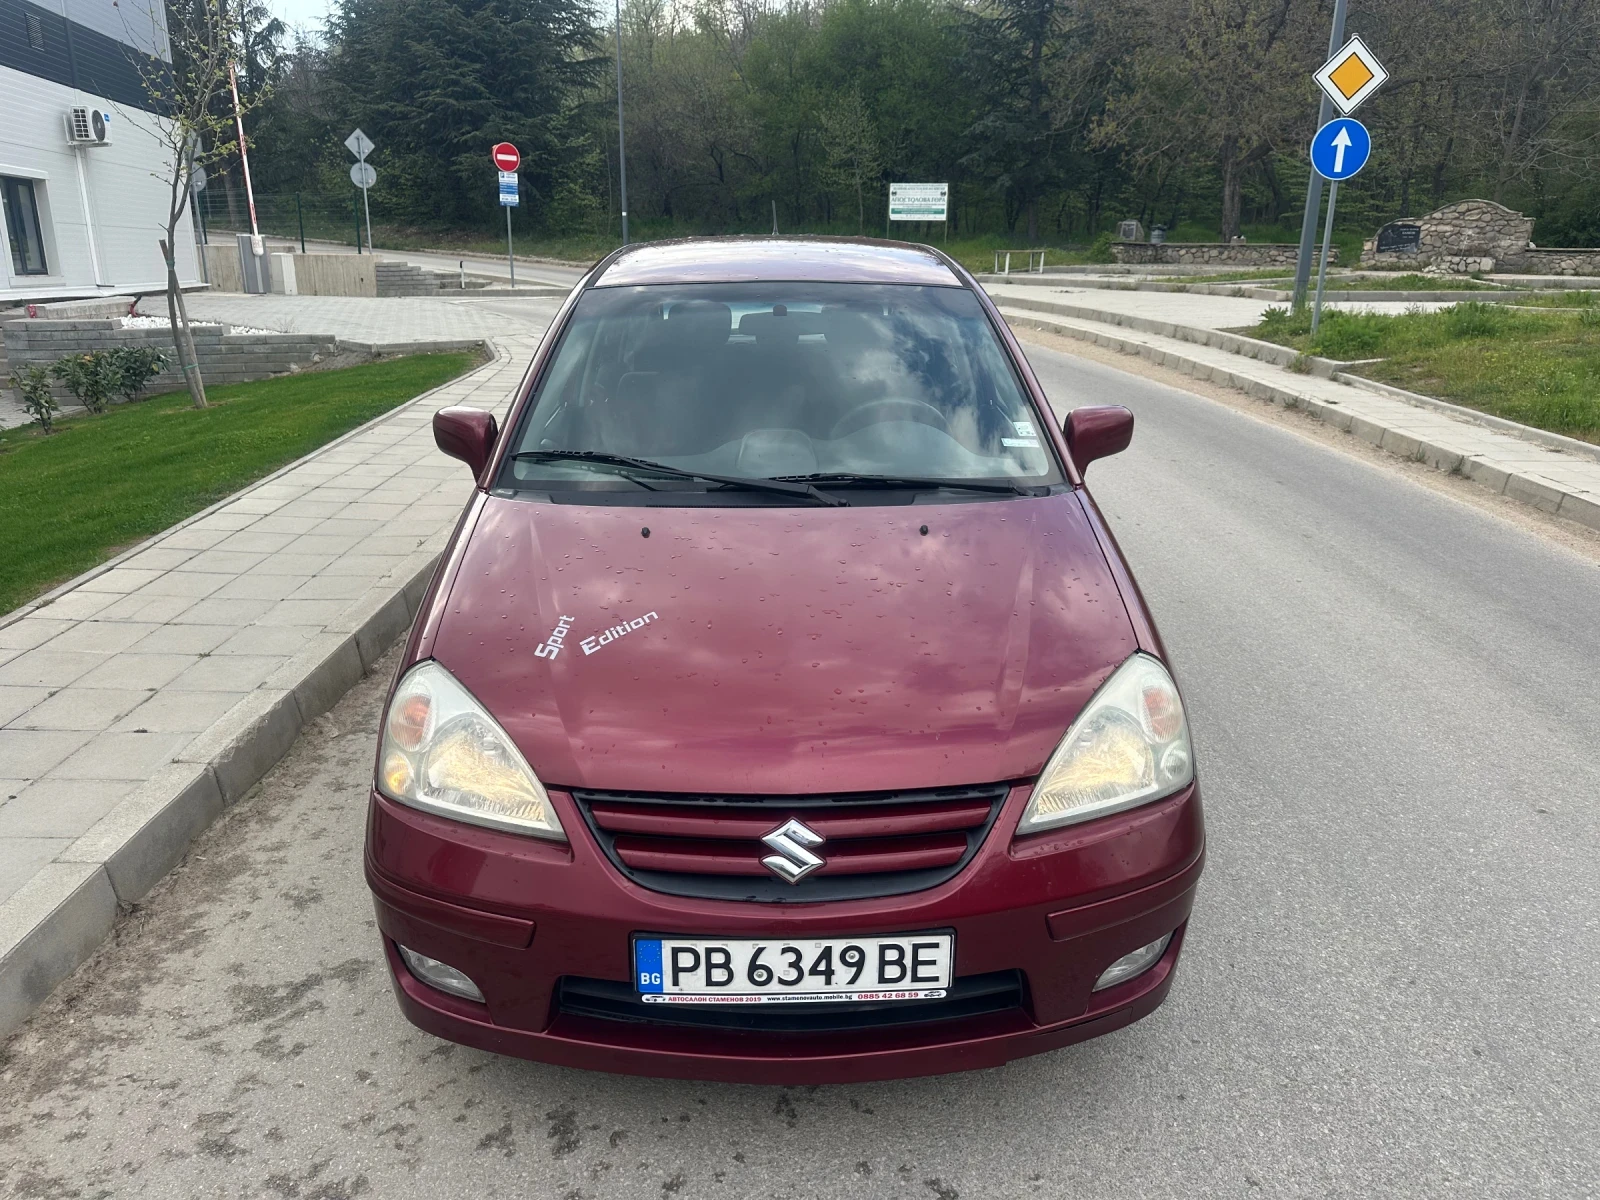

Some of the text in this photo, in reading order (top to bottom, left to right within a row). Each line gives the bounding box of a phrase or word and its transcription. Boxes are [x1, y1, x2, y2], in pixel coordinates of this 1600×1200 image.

[534, 615, 575, 660] Sport
[579, 611, 659, 656] Edition
[640, 972, 661, 986] BG
[671, 942, 940, 987] PB 6349 BE
[767, 993, 853, 1002] www.stamenovauto.mobile.bg
[857, 992, 880, 1000] 0885
[908, 991, 919, 999] 59
